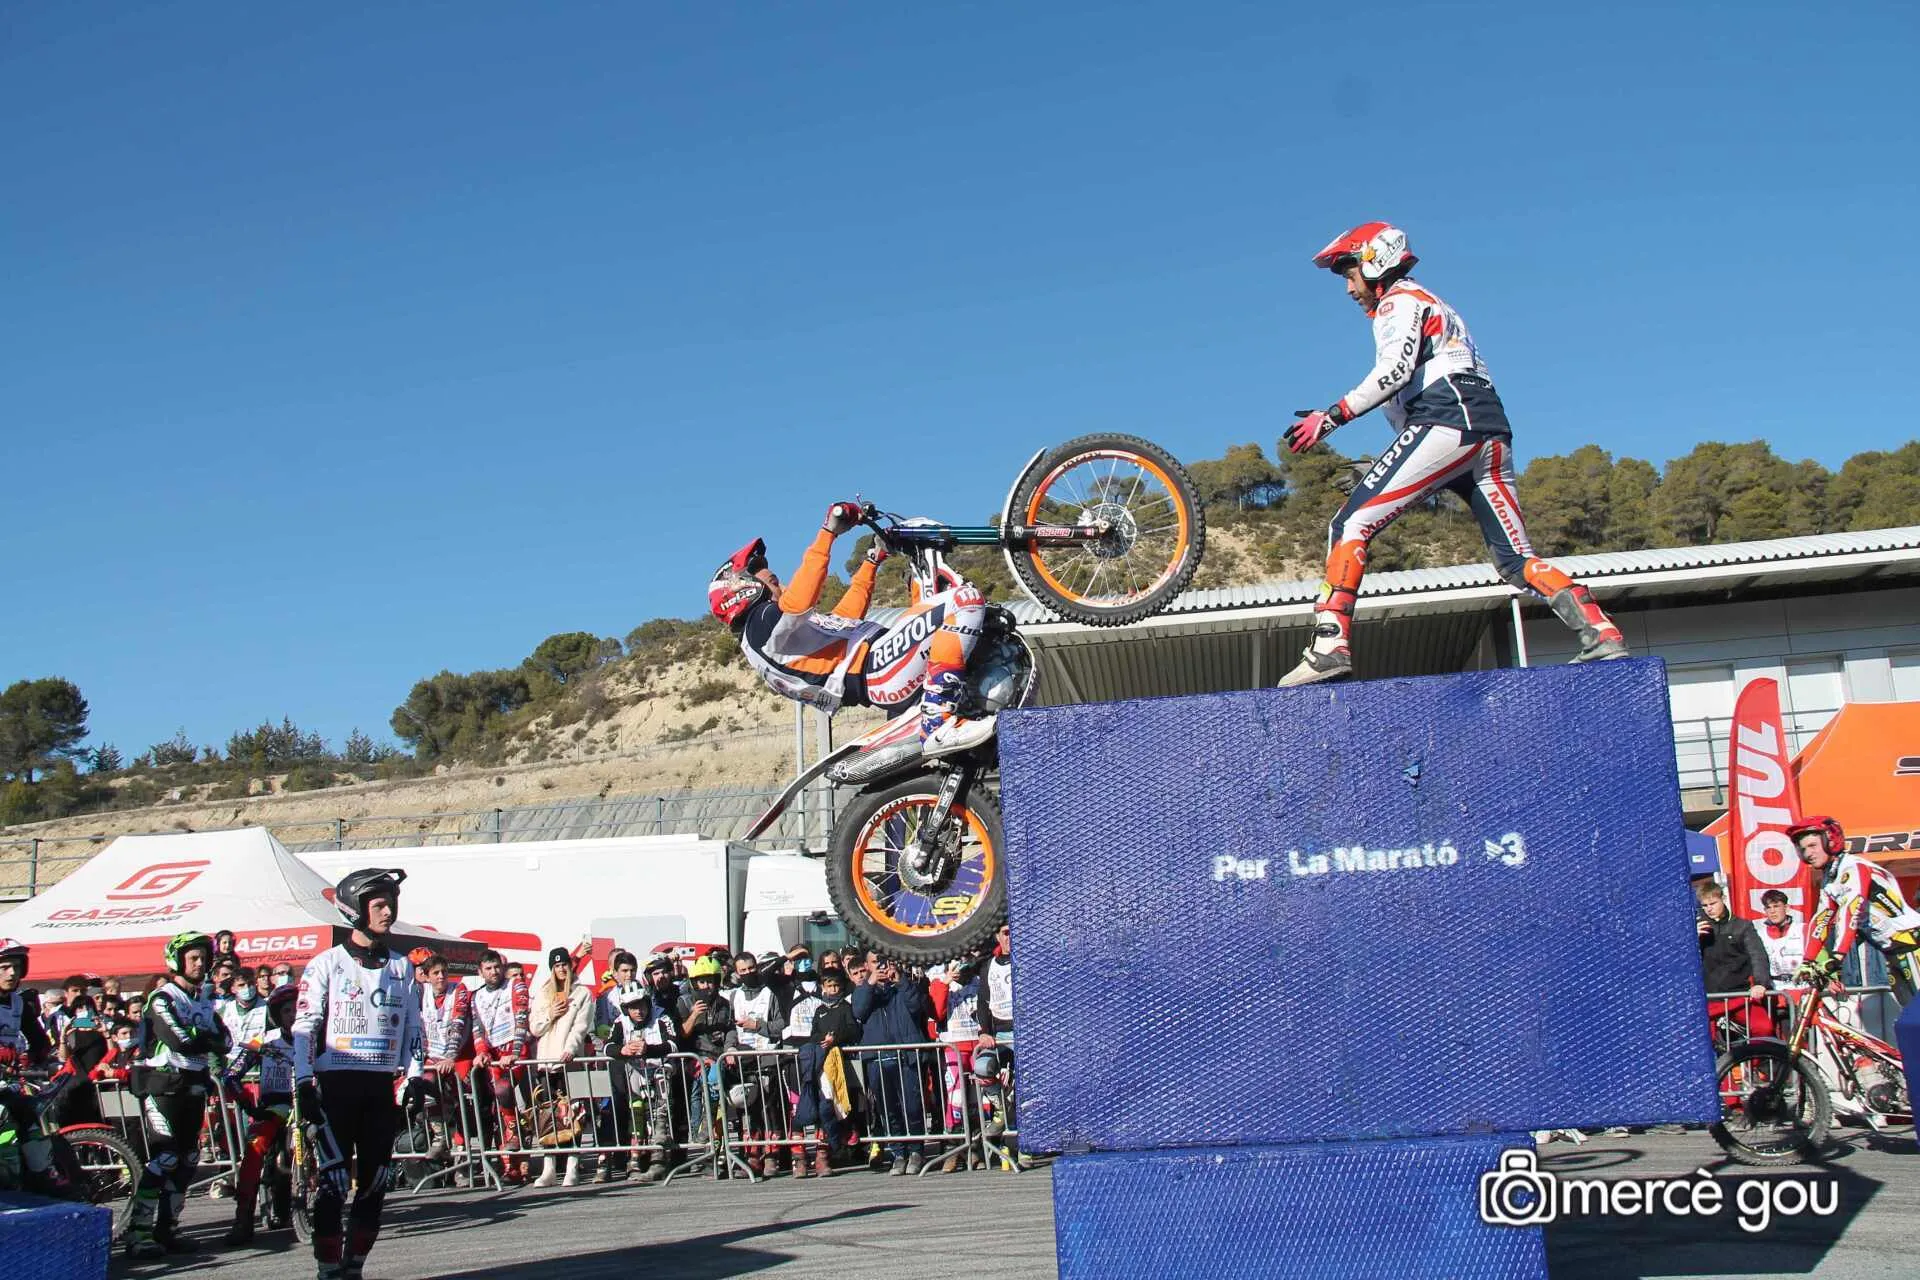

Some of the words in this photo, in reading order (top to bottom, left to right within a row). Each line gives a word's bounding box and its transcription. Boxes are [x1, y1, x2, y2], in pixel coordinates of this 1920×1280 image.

[1378, 335, 1416, 391] REPSOL
[1363, 424, 1423, 490] REPSOL
[720, 588, 757, 611] hebo
[872, 610, 936, 670] REPSOL
[868, 673, 926, 702] Monte
[1213, 855, 1268, 881] Per
[1288, 850, 1328, 876] La
[31, 920, 110, 929] FACTORY
[114, 914, 183, 926] RACING
[47, 900, 204, 921] GASGAS
[234, 934, 319, 953] ASGAS
